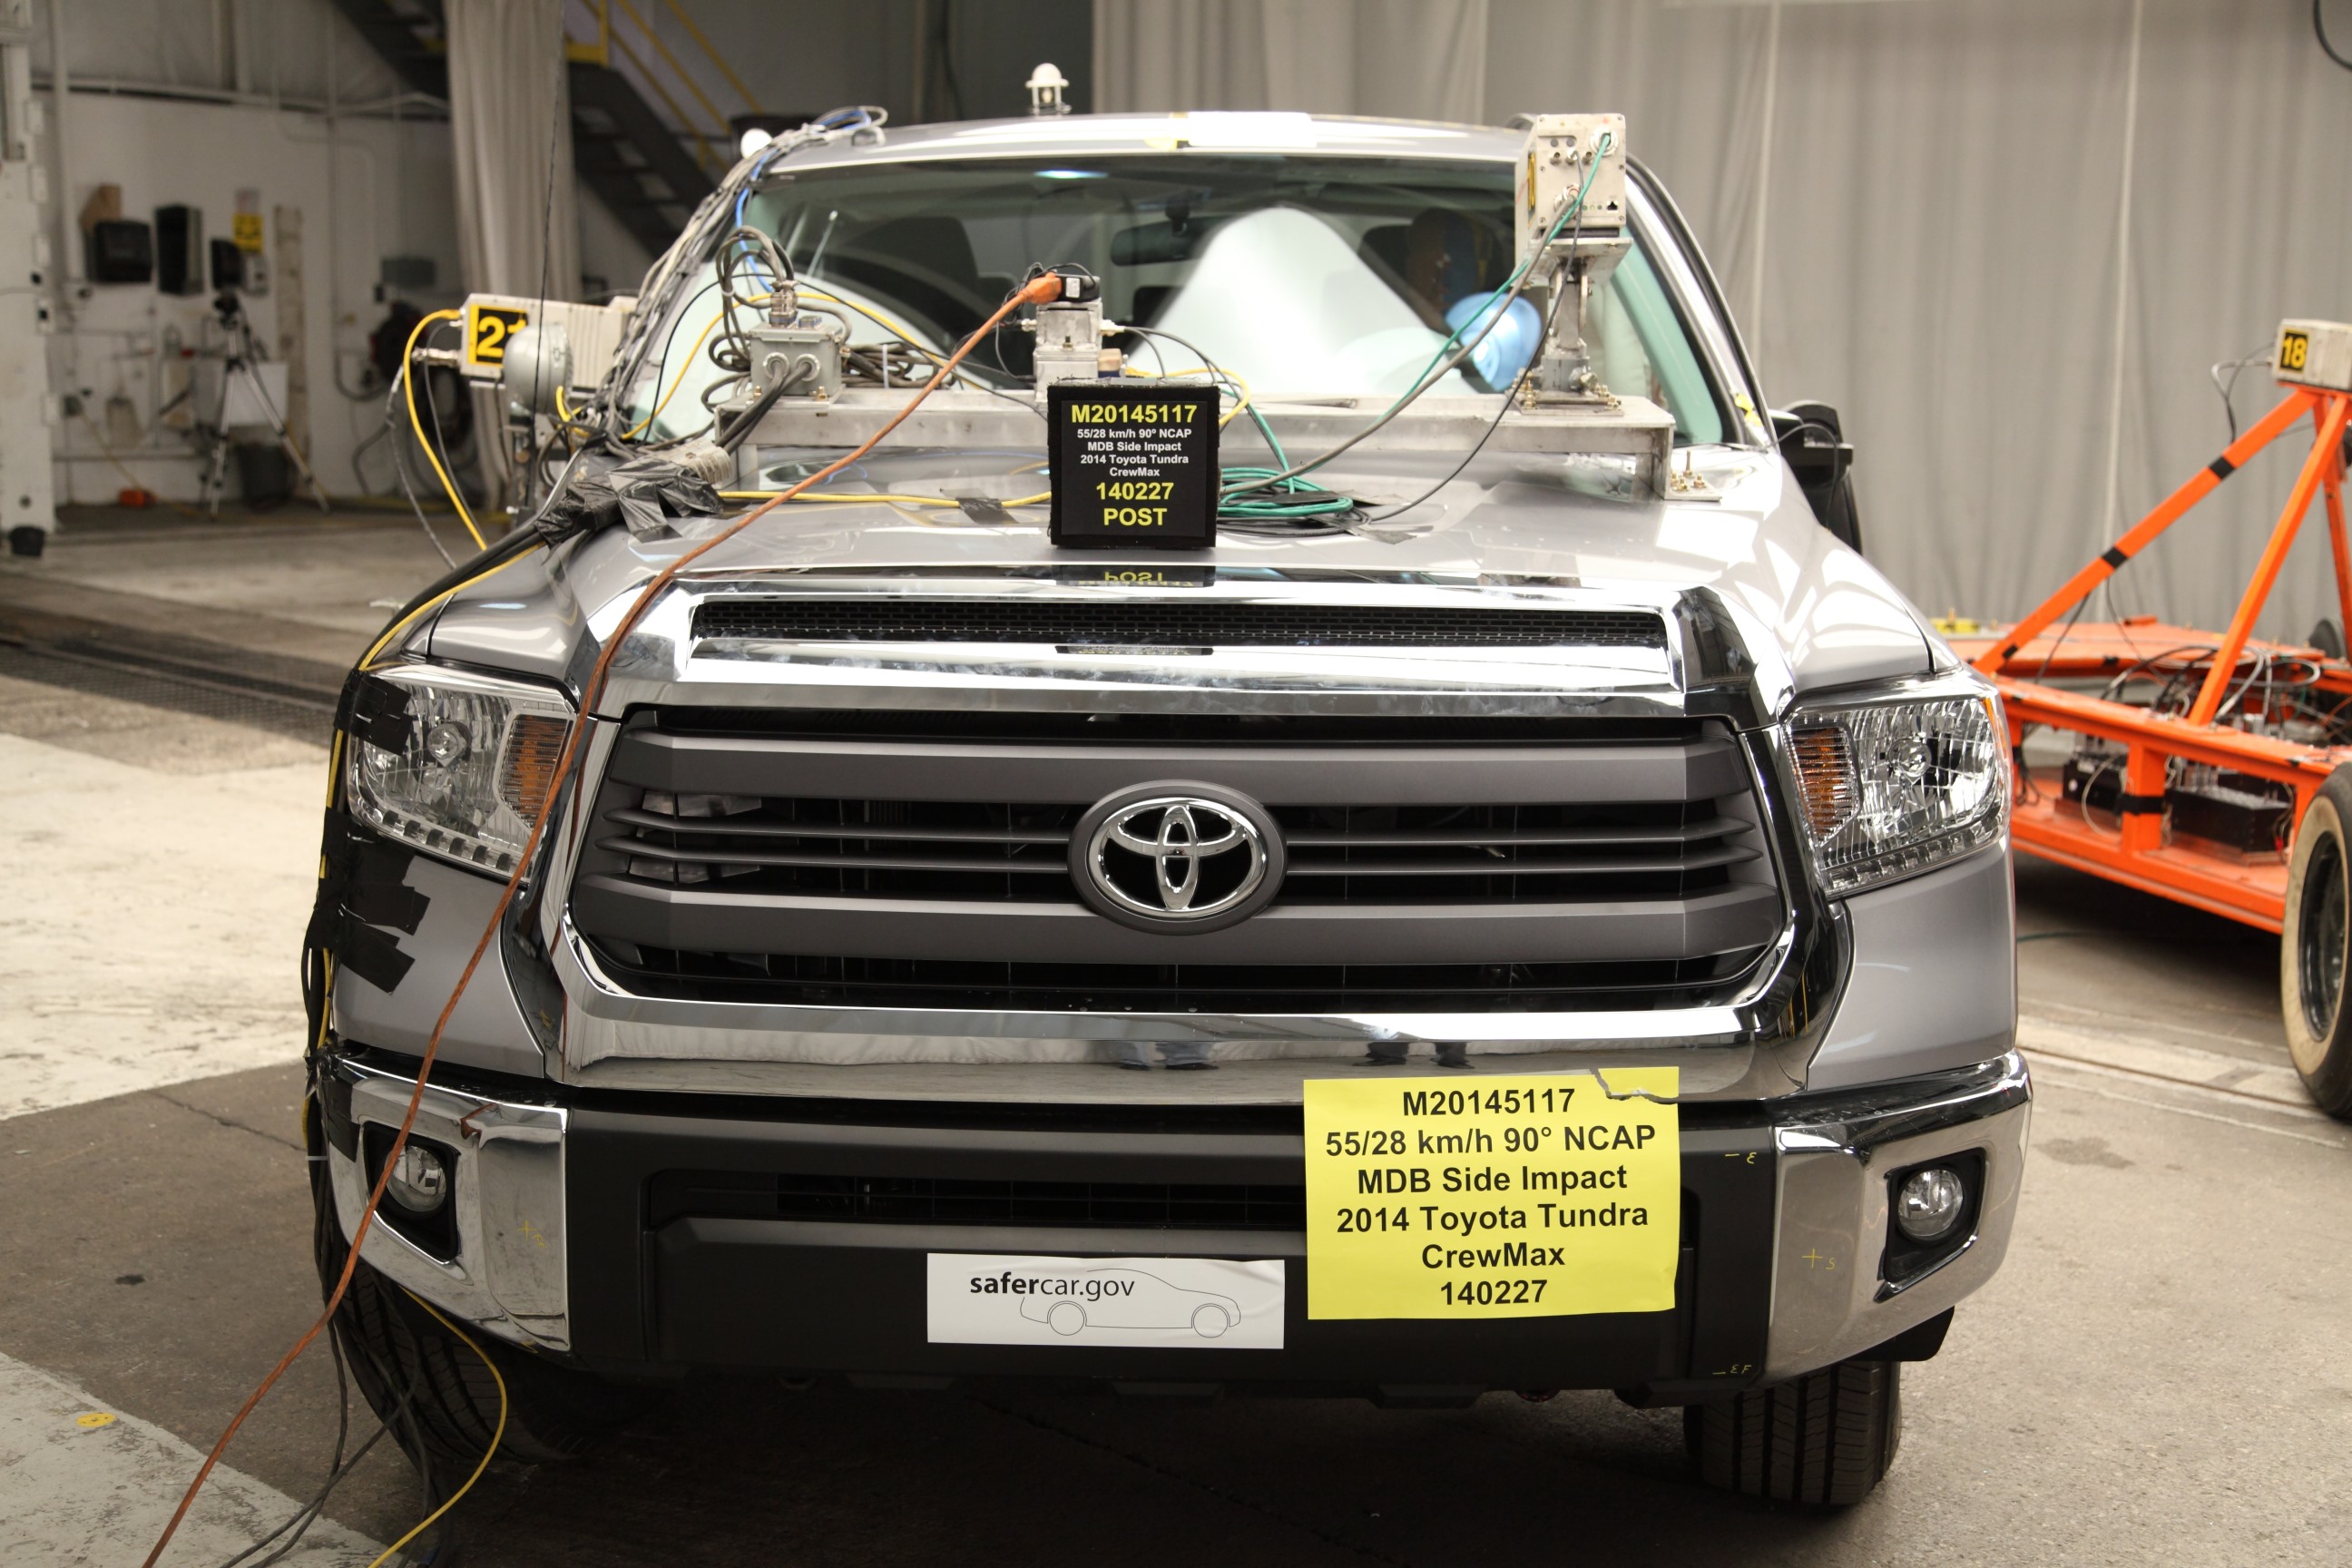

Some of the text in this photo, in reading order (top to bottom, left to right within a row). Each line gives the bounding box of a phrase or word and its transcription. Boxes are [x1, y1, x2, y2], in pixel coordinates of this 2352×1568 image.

[2283, 336, 2308, 368] 18
[1071, 405, 1198, 423] M20145117
[1077, 428, 1106, 438] 55/28
[1109, 428, 1136, 438] km/h
[1159, 428, 1192, 438] NCAP
[1081, 455, 1189, 466] 2014 Toyota Tundra
[1087, 442, 1181, 454] MDB Side Impact
[1110, 467, 1160, 476] CrewMax
[1096, 482, 1174, 500] 140227
[1103, 508, 1167, 525] POST
[1403, 1089, 1575, 1116] M20145117
[1326, 1124, 1655, 1156] 55/28 km/h 90° NCAP
[1358, 1164, 1627, 1195] MDB Side Impact
[1337, 1202, 1649, 1236] 2014 Toyota Tundra
[1422, 1242, 1565, 1269] CrewMax
[970, 1271, 1135, 1301] safercar.gov
[1441, 1279, 1548, 1306] 140227
